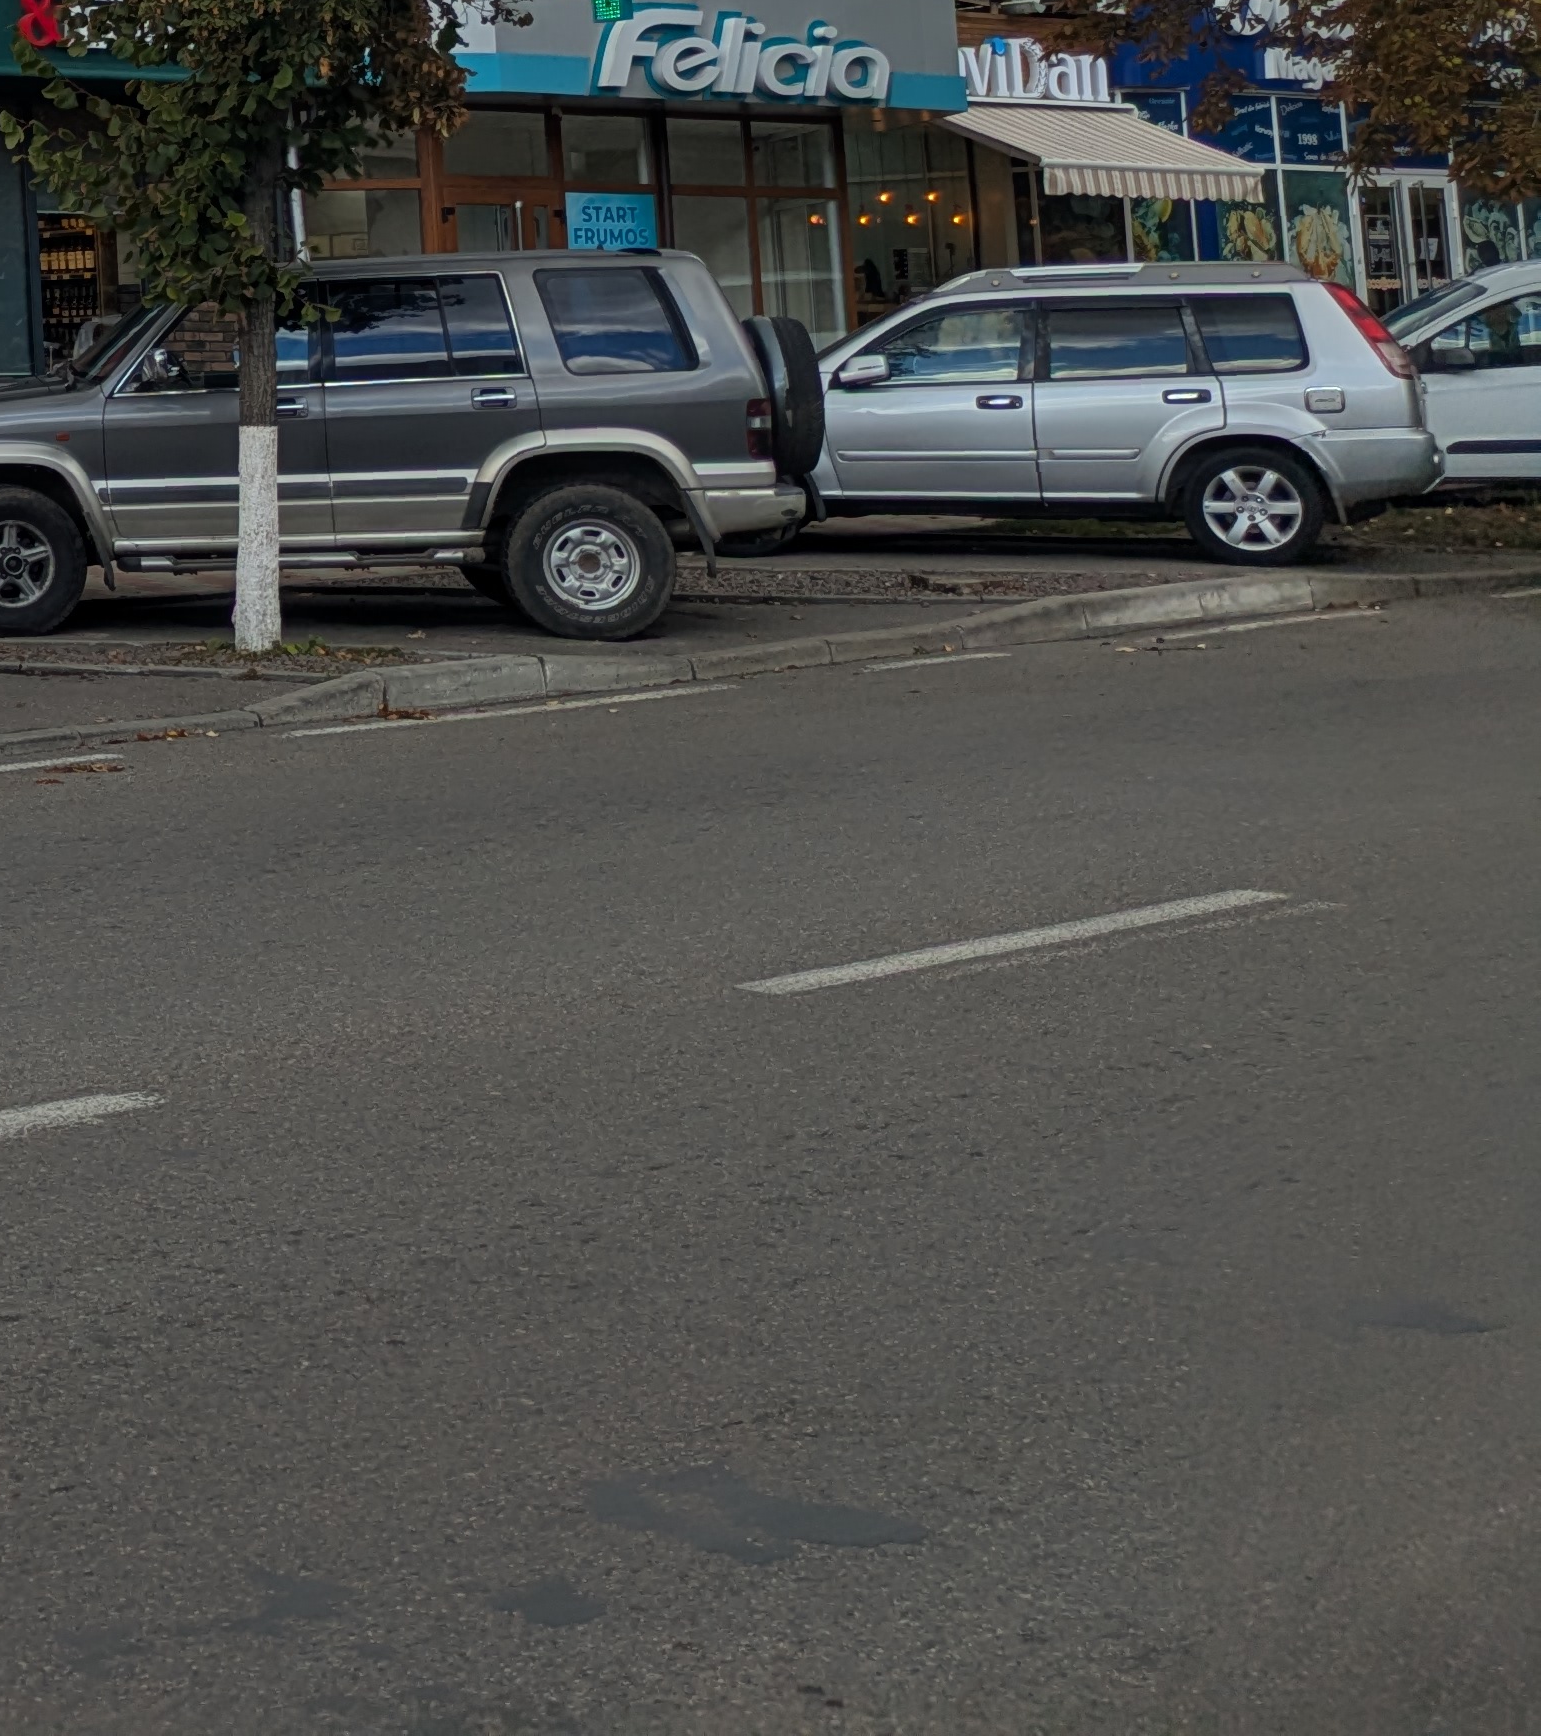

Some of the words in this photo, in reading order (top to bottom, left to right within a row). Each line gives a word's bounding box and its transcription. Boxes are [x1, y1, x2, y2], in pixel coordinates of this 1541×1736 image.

[596, 8, 891, 100] Felicia
[581, 205, 638, 223] START
[573, 227, 649, 245] FRUMOS
